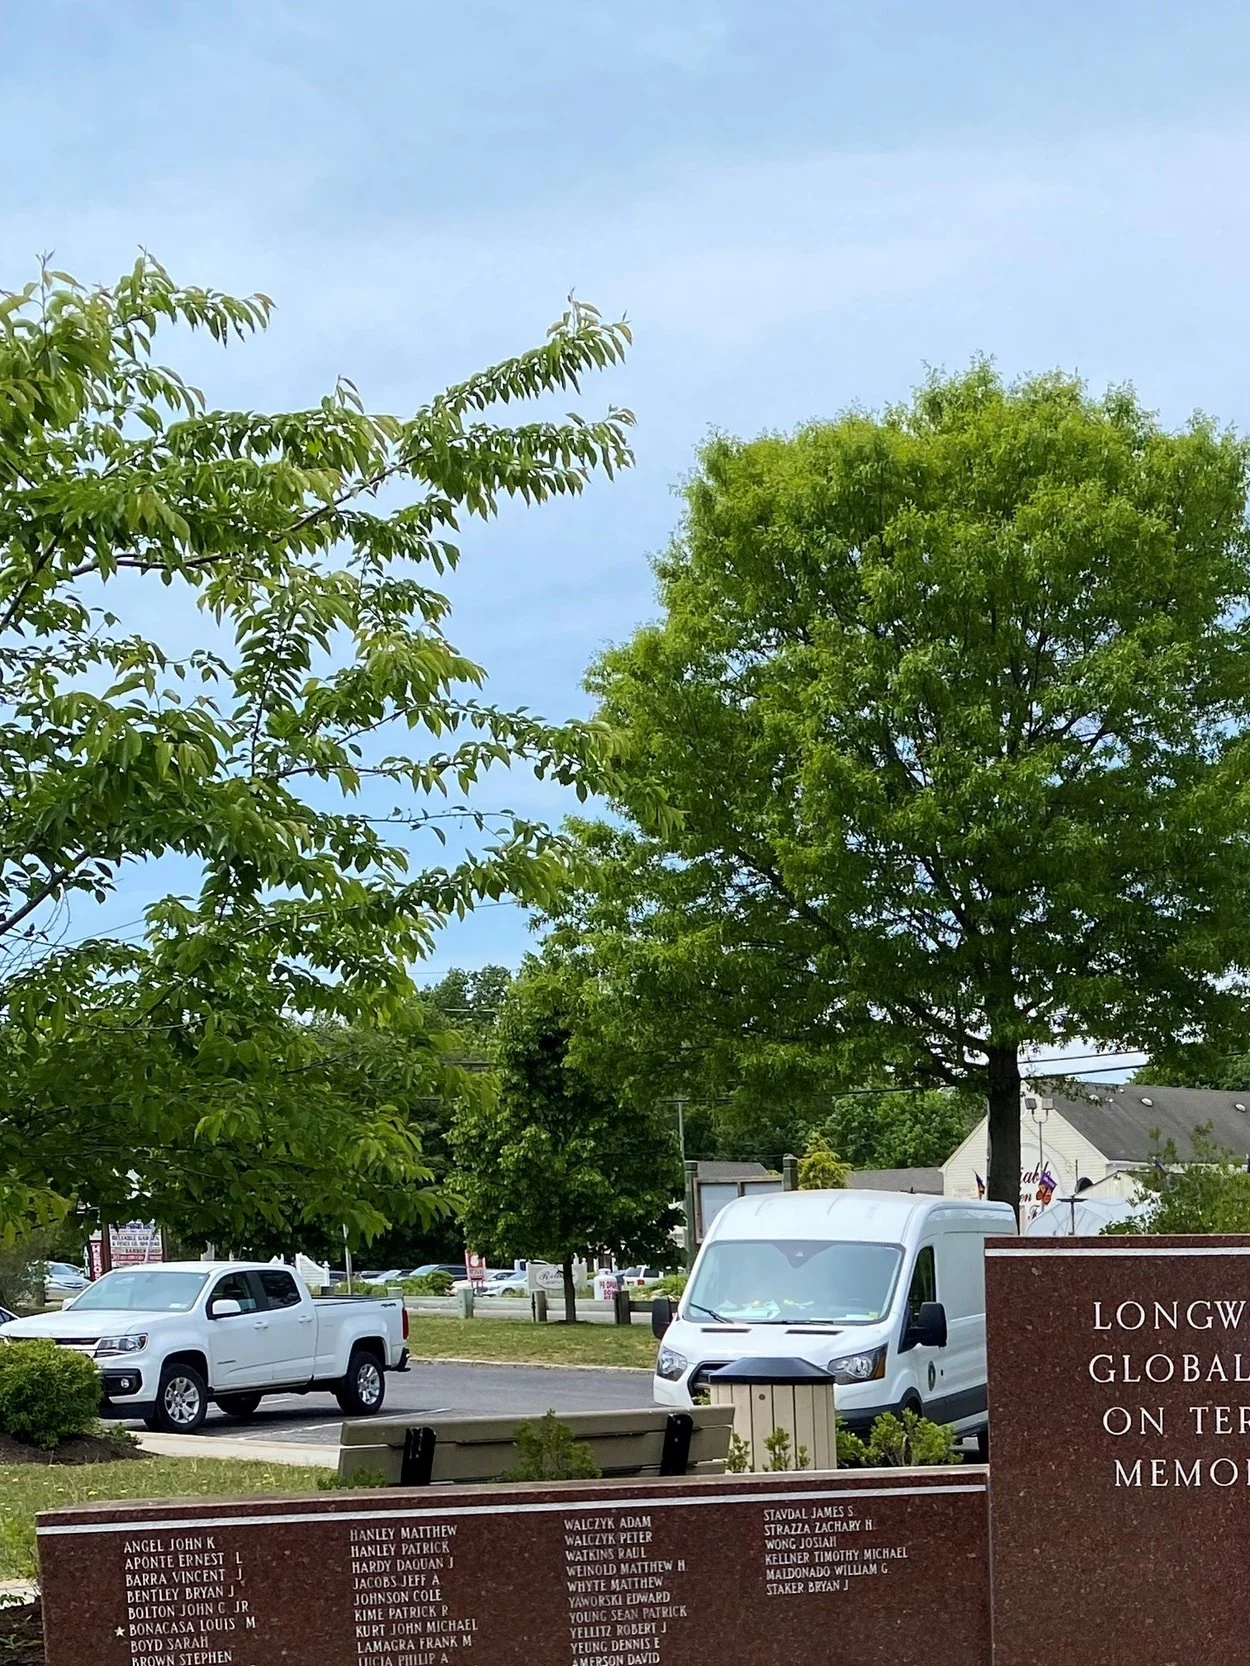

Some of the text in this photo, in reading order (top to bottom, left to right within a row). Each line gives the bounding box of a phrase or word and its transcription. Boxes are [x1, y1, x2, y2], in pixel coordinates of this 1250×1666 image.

[1102, 1406, 1165, 1436] ON
[564, 1516, 652, 1531] WALCZYK ADAM
[351, 1525, 457, 1542] HANLEY MATTHEW
[565, 1531, 653, 1546] WALCZYK PETER
[124, 1537, 215, 1553] ANGEL JOHN K
[351, 1541, 450, 1557] HANLEY PATRICK
[765, 1536, 837, 1550] WONG JOSIAH
[565, 1547, 647, 1562] WATKINS RAUL
[765, 1547, 908, 1565] KELLNER TIMOTHY MICHAEL
[567, 1577, 664, 1592] WHYTE MATTHEW
[767, 1579, 849, 1595] STAKER BRYAN J
[354, 1589, 442, 1606] JOHNSON COLE
[569, 1591, 670, 1608] YAWORSKI EDWARD
[128, 1601, 249, 1620] BOLTON JOHN C JR
[569, 1606, 687, 1624] YOUNG SEAN PATRICK
[356, 1619, 479, 1638] KURT JOHN MICHAEL
[617, 1623, 657, 1636] ROBERT
[661, 1622, 667, 1633] J
[131, 1636, 209, 1653] BOYD SARAH
[357, 1635, 472, 1654] LAMAGRA FRANK M
[179, 1650, 232, 1665] STEPHEN
[628, 1652, 660, 1666] DAVID
